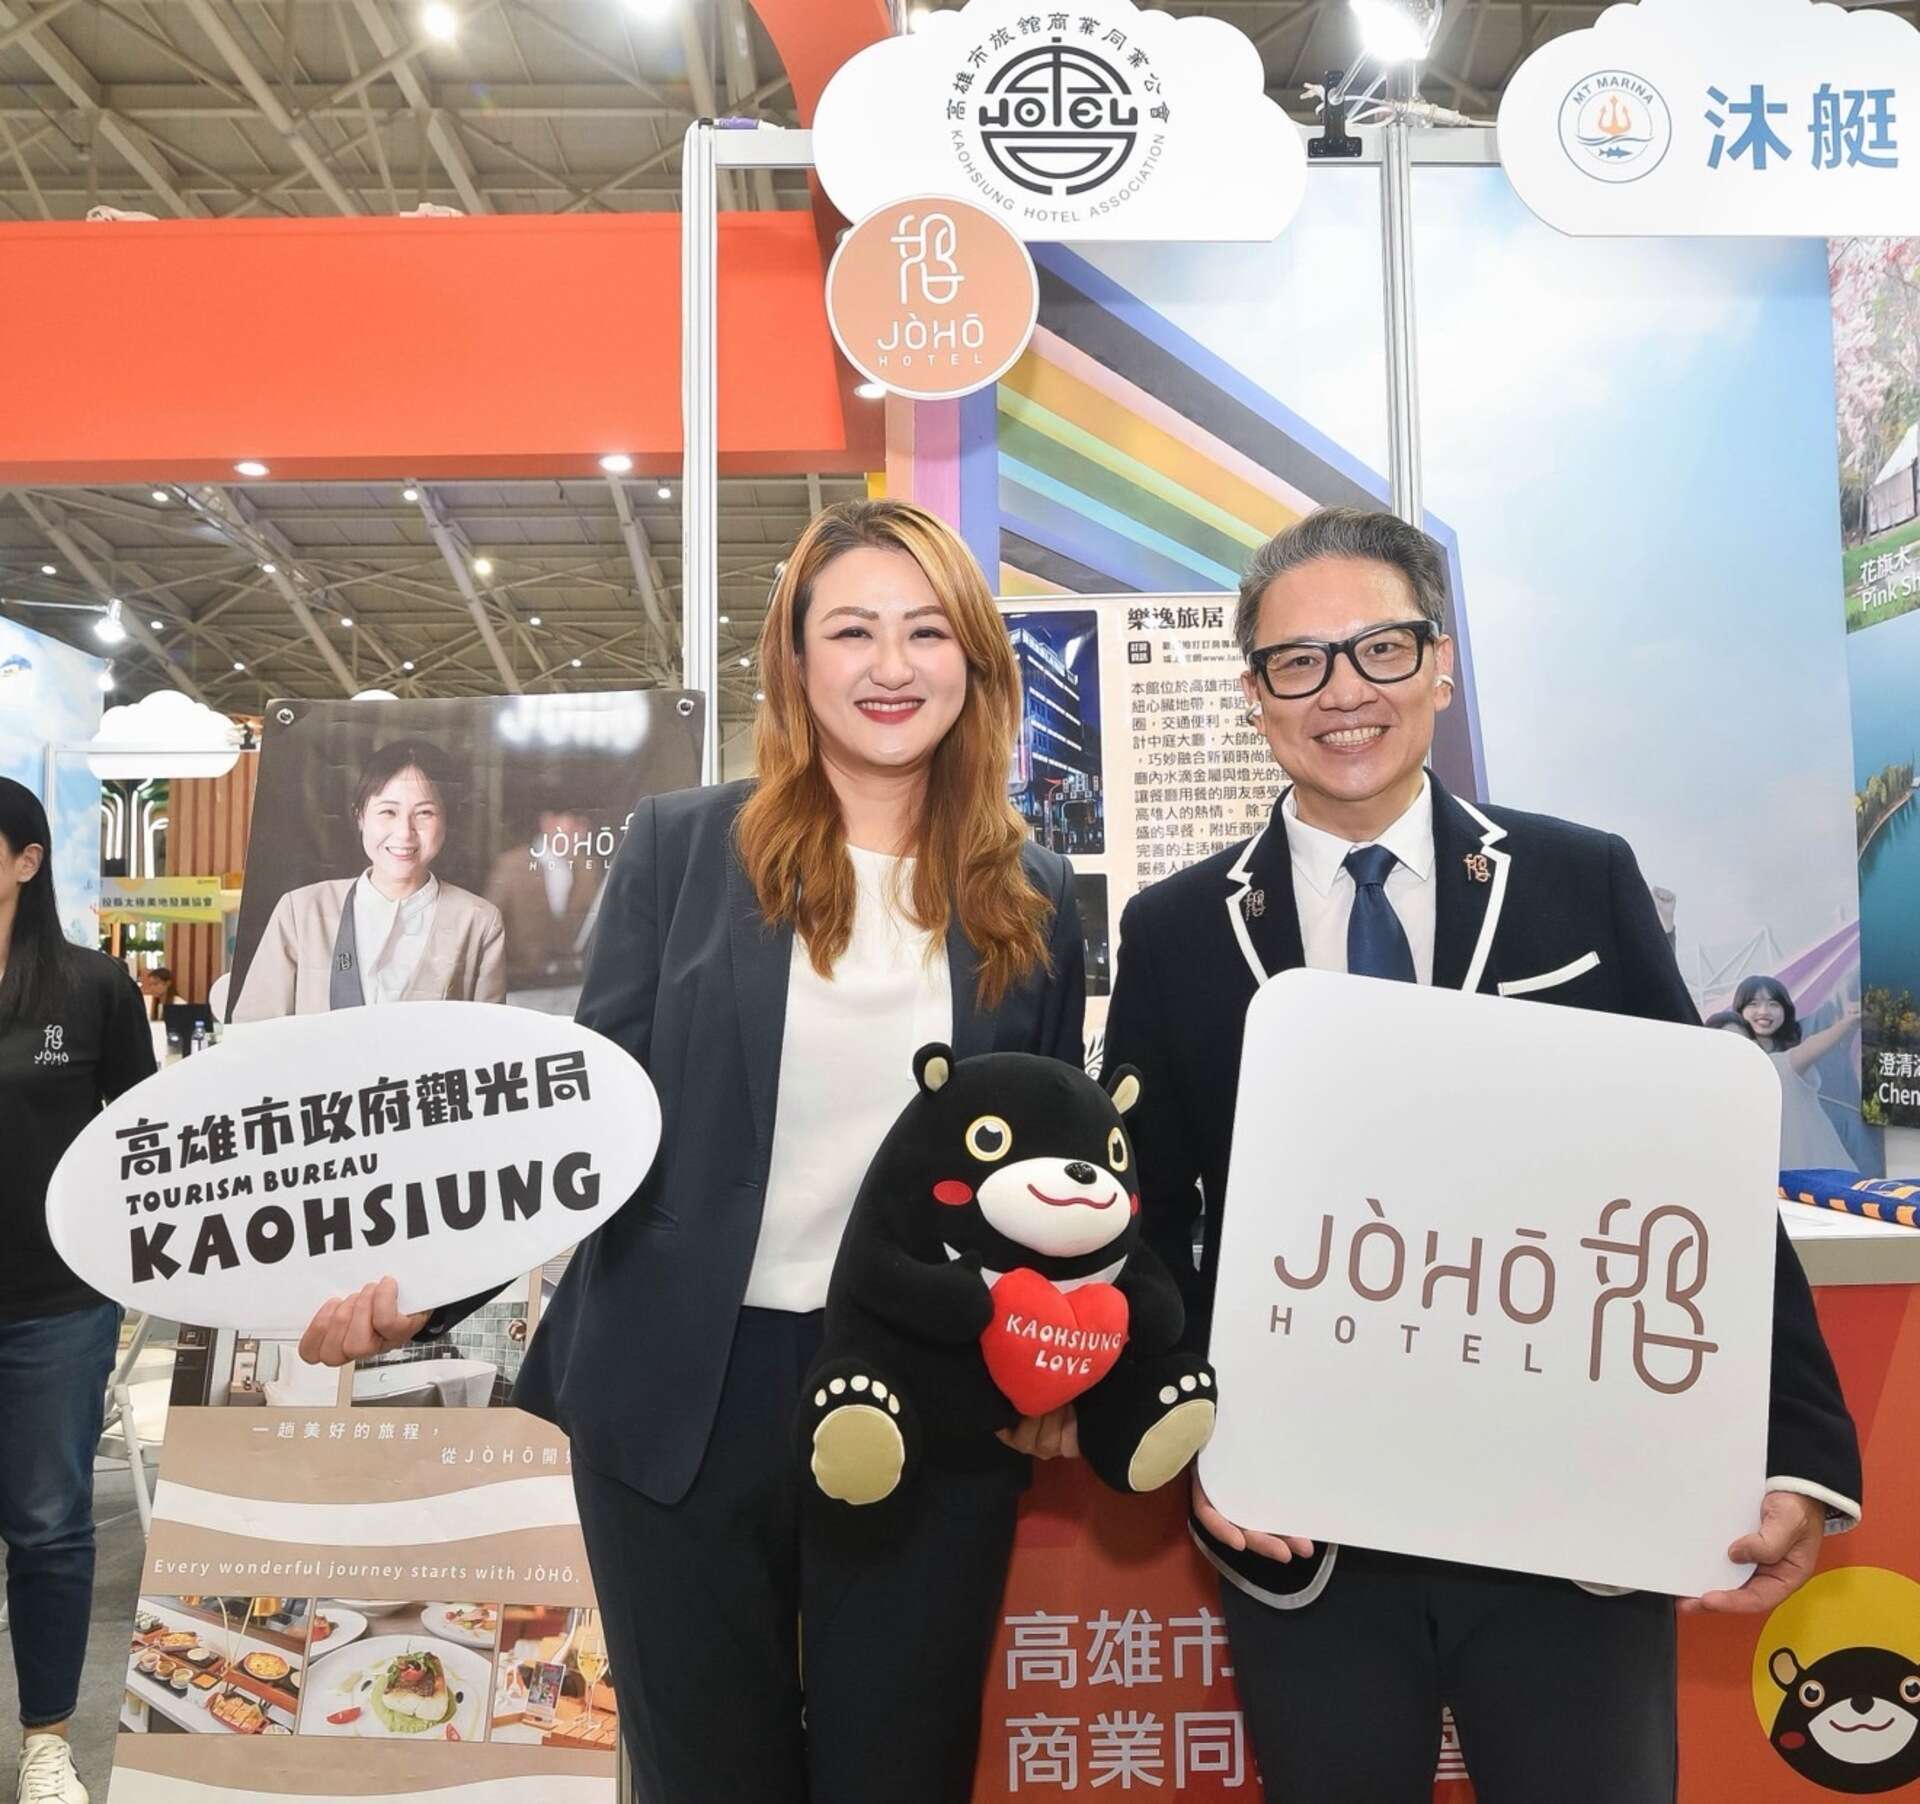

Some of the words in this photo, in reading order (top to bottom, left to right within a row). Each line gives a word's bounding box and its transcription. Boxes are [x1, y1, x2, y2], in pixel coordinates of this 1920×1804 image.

[946, 12, 1170, 123] 高雄市旅館商業同業公會
[1573, 84, 1593, 106] MT
[1597, 76, 1654, 106] MARINA
[1704, 83, 1899, 171] 沐艇
[951, 129, 1015, 211] KAOHSIUNG
[1024, 206, 1080, 223] HOTEL
[1089, 134, 1165, 218] ASSOCIATION
[879, 353, 983, 366] HOTEL
[1861, 581, 1897, 611] Pink
[1135, 786, 1283, 803] 讓餐廳用餐的朋友感受
[529, 860, 611, 873] HOTEL
[116, 1050, 591, 1181] 高雄市政府觀光局
[126, 1172, 253, 1215] TOURISM
[264, 1152, 379, 1193] BUREAU
[130, 1151, 600, 1283] KAOHSIUNG
[1006, 1314, 1122, 1350] KAOHSIUNG
[1035, 1350, 1092, 1375] LOVE
[1270, 1305, 1543, 1373] HOTEL
[154, 1559, 210, 1577] Every
[219, 1560, 321, 1576] wonderful
[328, 1561, 402, 1580] journey
[411, 1565, 467, 1579] starts
[475, 1565, 516, 1581] with
[1004, 1607, 1235, 1690] 高雄市
[1005, 1709, 1263, 1793] 商業同
